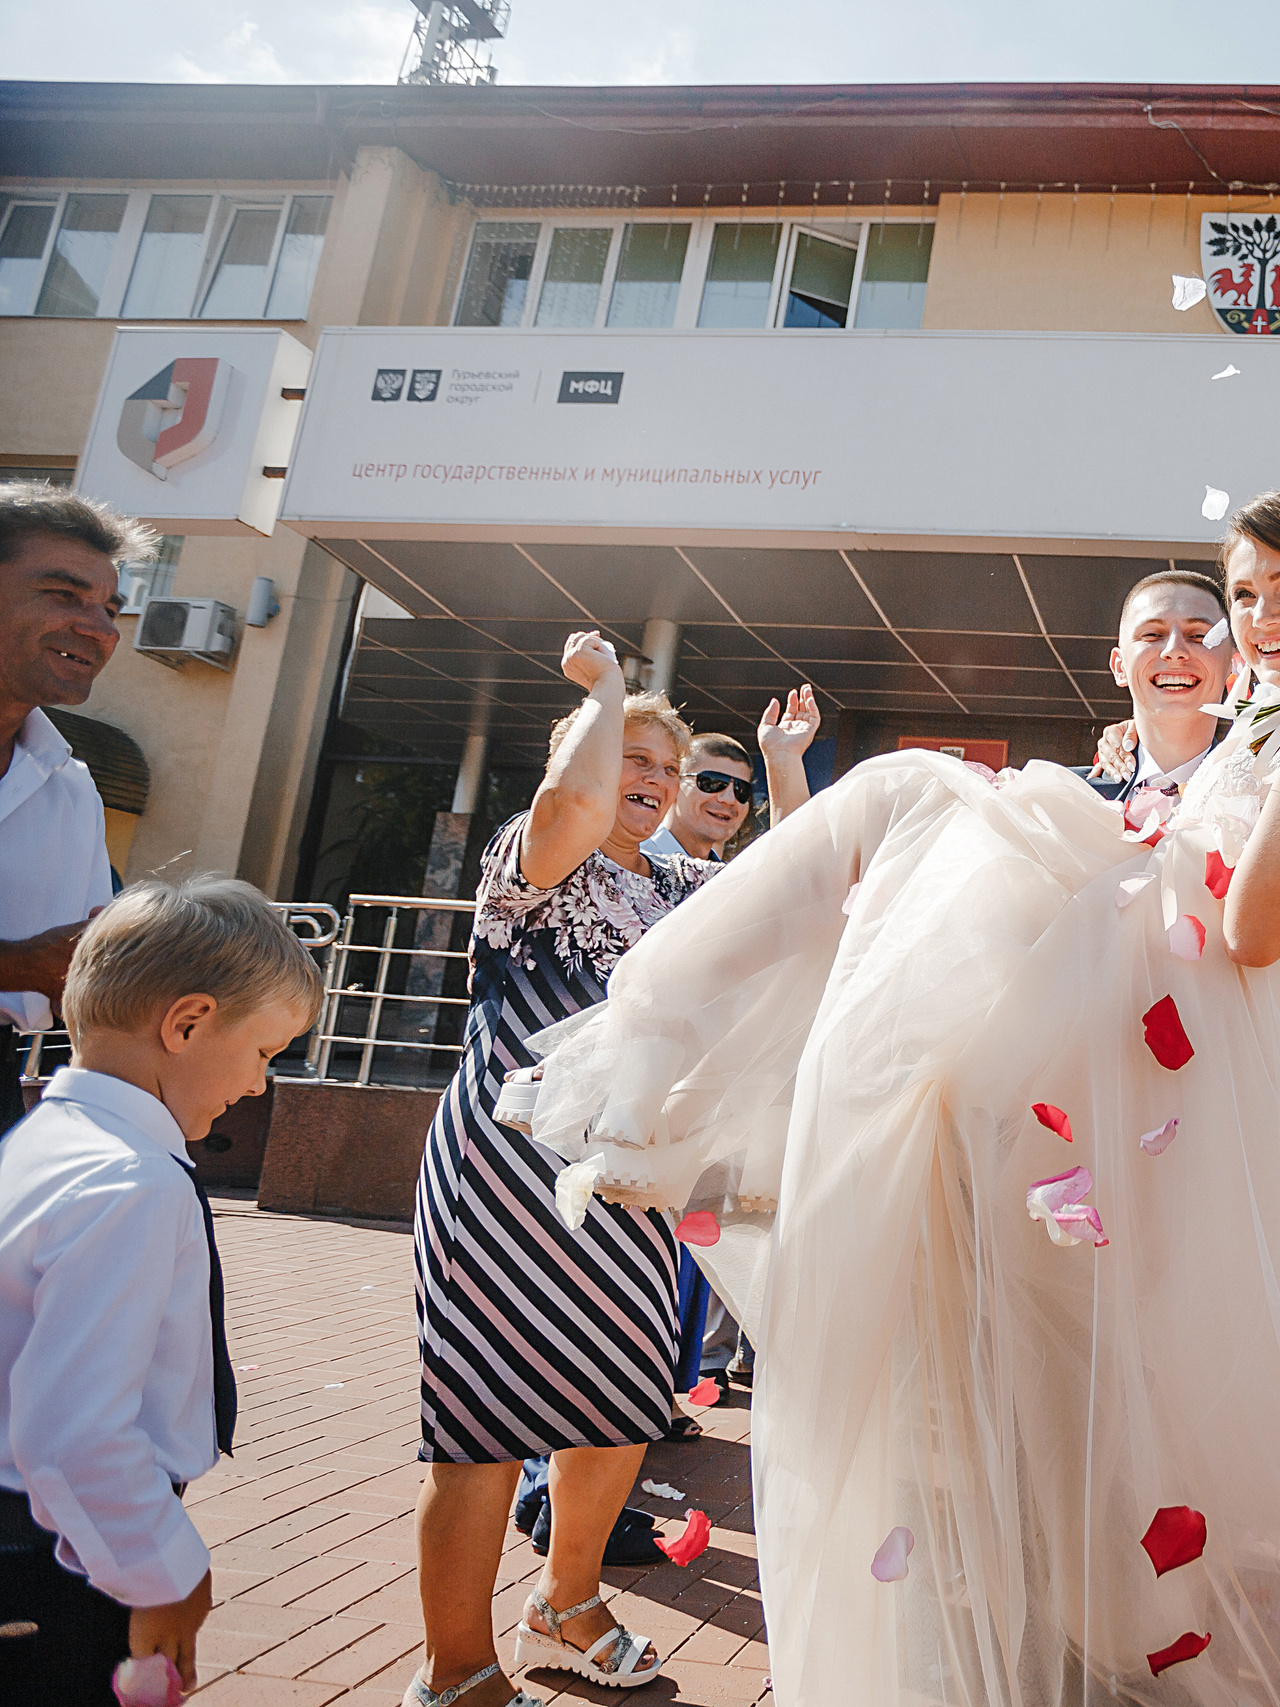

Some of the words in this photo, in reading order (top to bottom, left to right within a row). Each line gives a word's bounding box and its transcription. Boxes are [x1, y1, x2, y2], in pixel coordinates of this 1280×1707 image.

[452, 369, 520, 380] Гурьевский
[449, 382, 514, 392] городской
[568, 379, 613, 396] МФЦ
[446, 396, 481, 406] округ
[352, 462, 408, 482] центр
[412, 463, 578, 484] государственных
[583, 467, 596, 482] и
[601, 467, 762, 487] муниципальных
[768, 468, 822, 491] услуг
